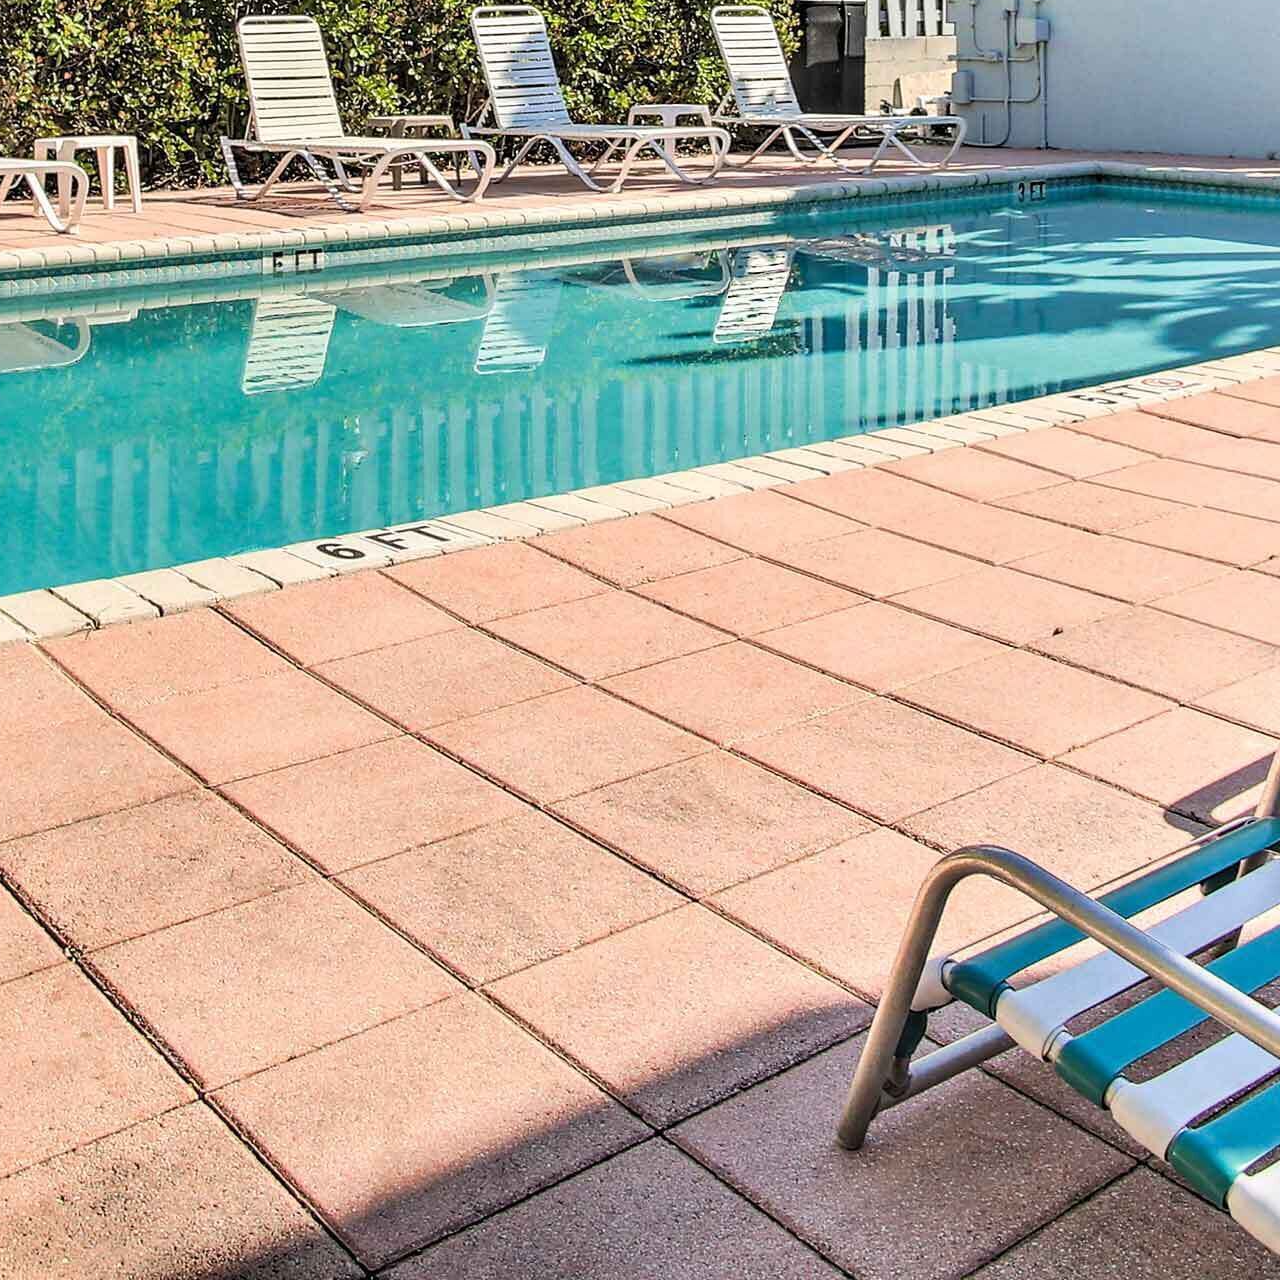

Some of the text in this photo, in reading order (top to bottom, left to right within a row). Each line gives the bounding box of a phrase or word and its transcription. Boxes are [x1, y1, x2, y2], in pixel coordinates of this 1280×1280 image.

[1096, 384, 1161, 400] FT
[316, 525, 451, 560] 6 FT
